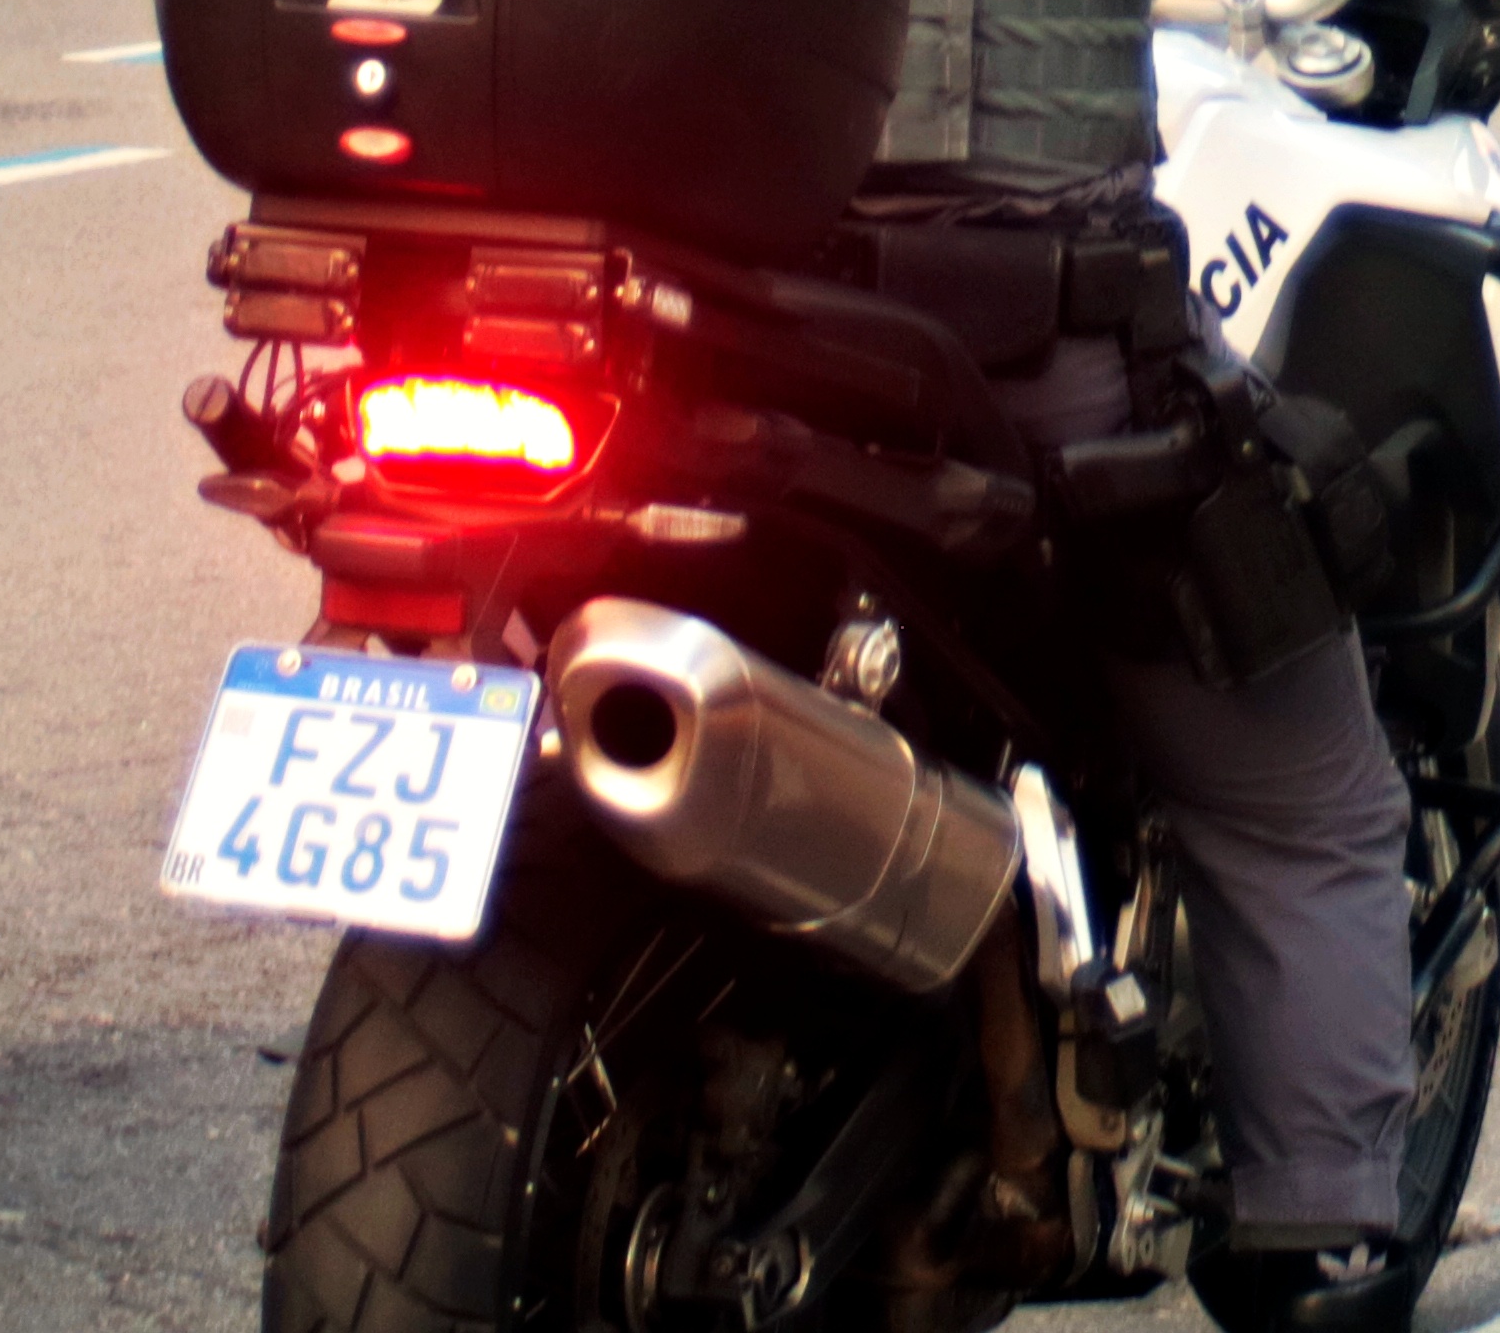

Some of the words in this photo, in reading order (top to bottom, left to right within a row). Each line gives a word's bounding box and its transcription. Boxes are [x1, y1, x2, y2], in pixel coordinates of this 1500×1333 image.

[318, 673, 432, 711] BRASIL
[268, 708, 457, 806] FZJ
[216, 795, 461, 903] 4G85
